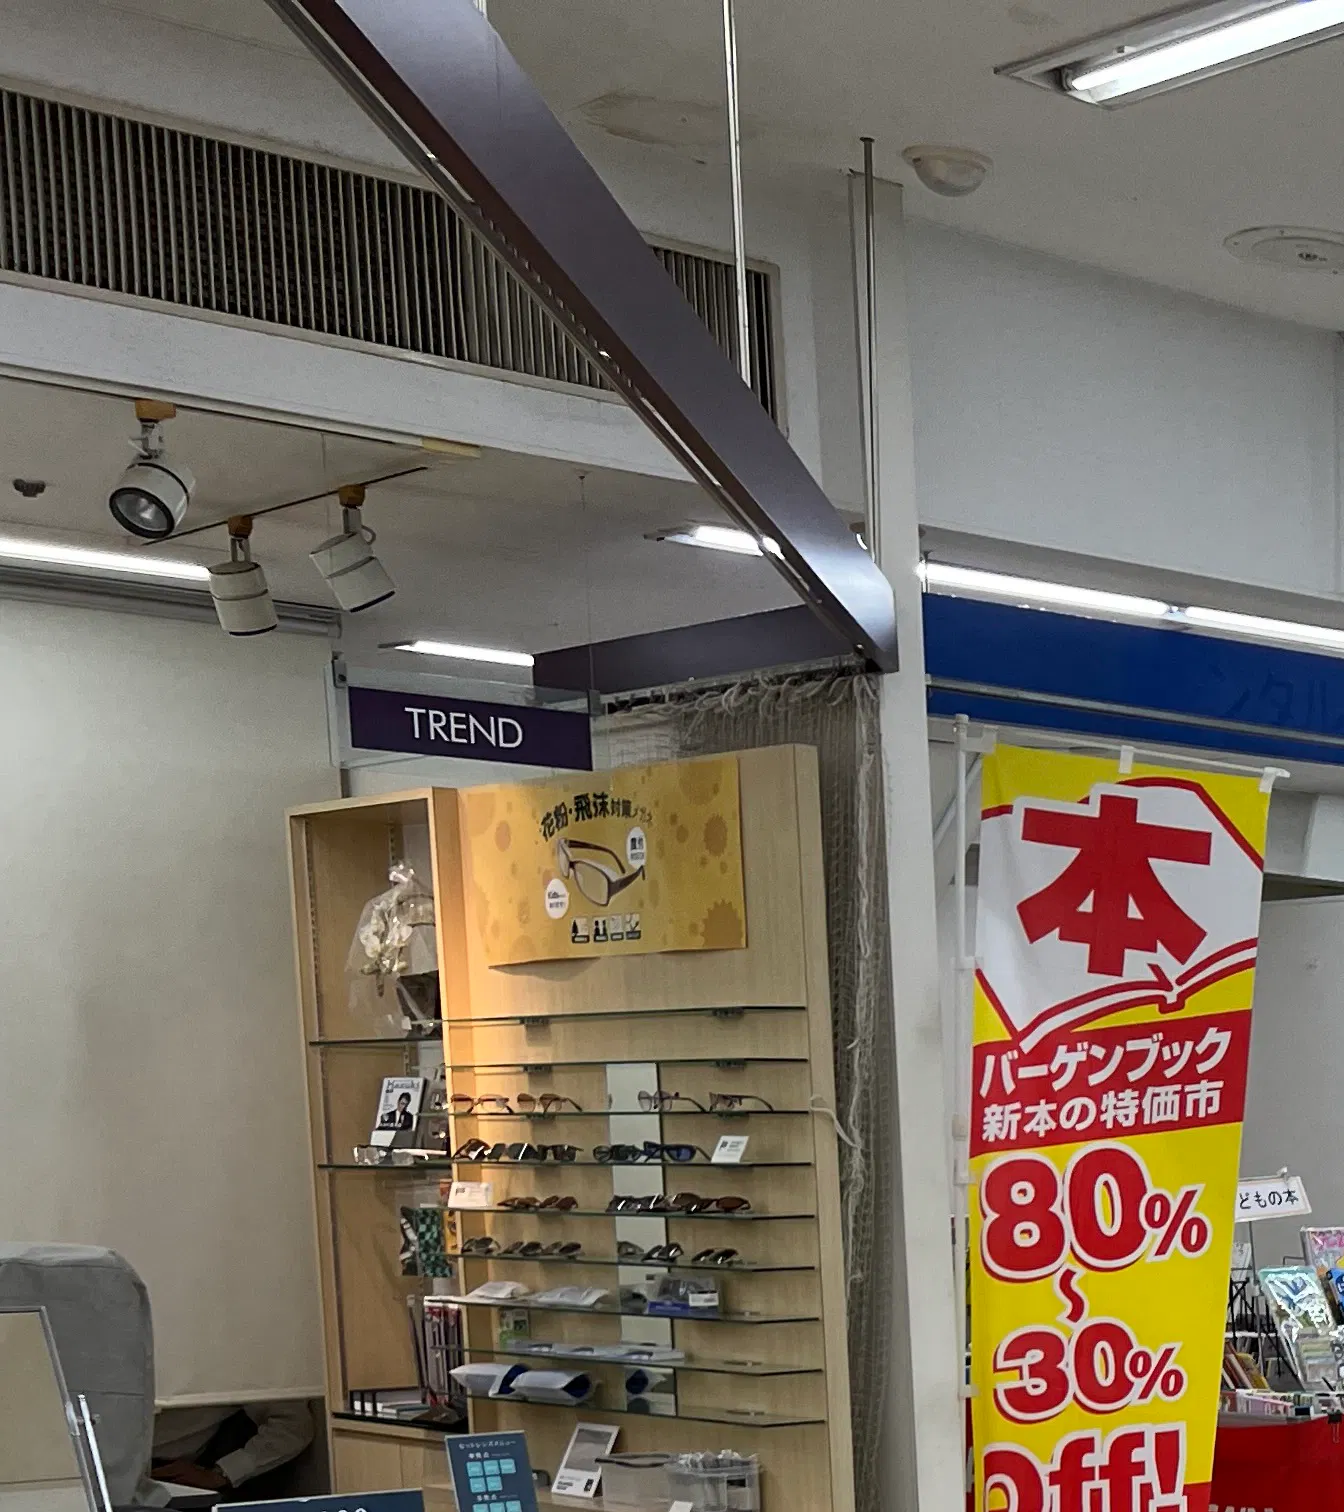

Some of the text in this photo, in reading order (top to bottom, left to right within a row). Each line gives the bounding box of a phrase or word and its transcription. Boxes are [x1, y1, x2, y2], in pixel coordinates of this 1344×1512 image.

[404, 706, 524, 750] TREND
[1017, 795, 1213, 977] 本
[979, 1027, 1232, 1099] バーゲンブック
[981, 1080, 1224, 1142] 新本の特価市
[979, 1140, 1214, 1284] 80%
[1239, 1189, 1299, 1210] どもの本
[993, 1317, 1188, 1425] 30%
